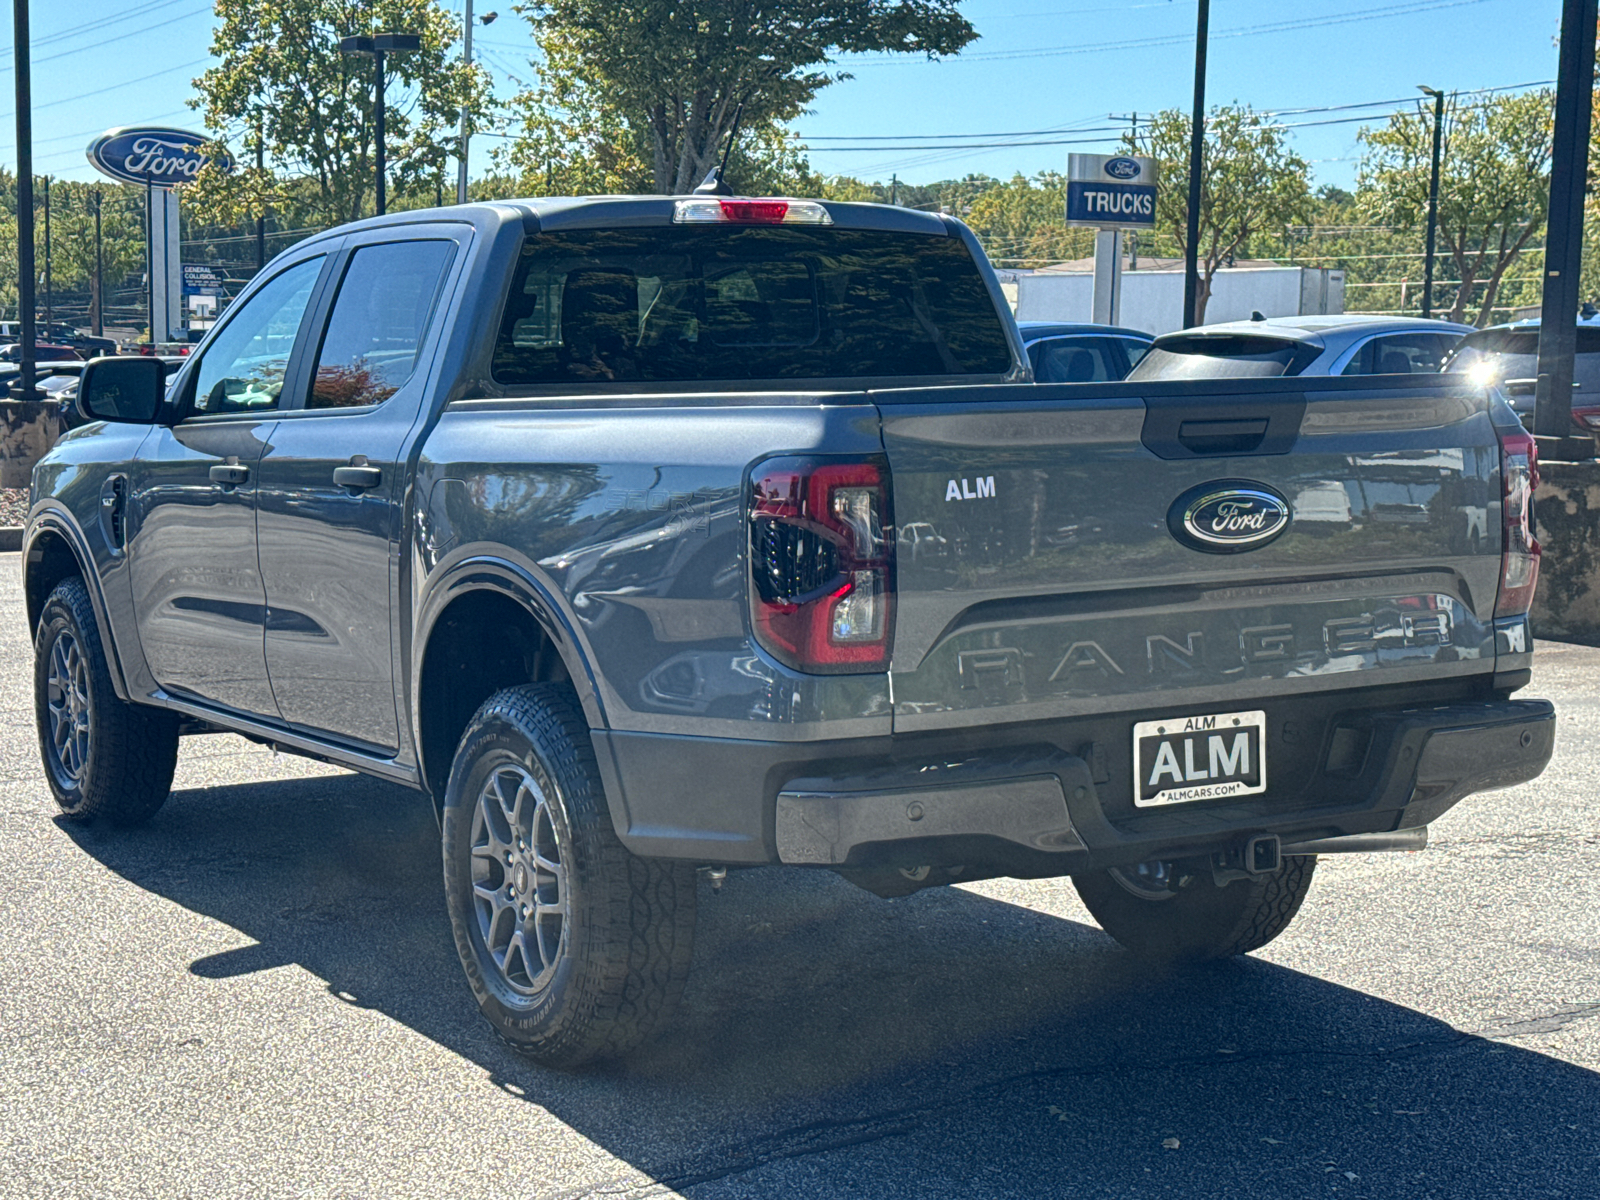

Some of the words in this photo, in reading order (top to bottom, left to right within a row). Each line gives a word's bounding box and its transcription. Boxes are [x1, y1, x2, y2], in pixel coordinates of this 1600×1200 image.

[124, 137, 206, 176] Ford
[1114, 161, 1136, 175] Ford
[1083, 191, 1152, 215] TRUCKS
[605, 488, 723, 514] SPORT
[945, 475, 996, 501] ALM
[1211, 501, 1267, 531] Ford
[957, 610, 1453, 690] RANGER
[1184, 716, 1216, 731] ALM
[1148, 732, 1250, 786] ALM
[1167, 785, 1236, 801] ALMCARS.COM
[517, 992, 556, 1030] TERRITORY
